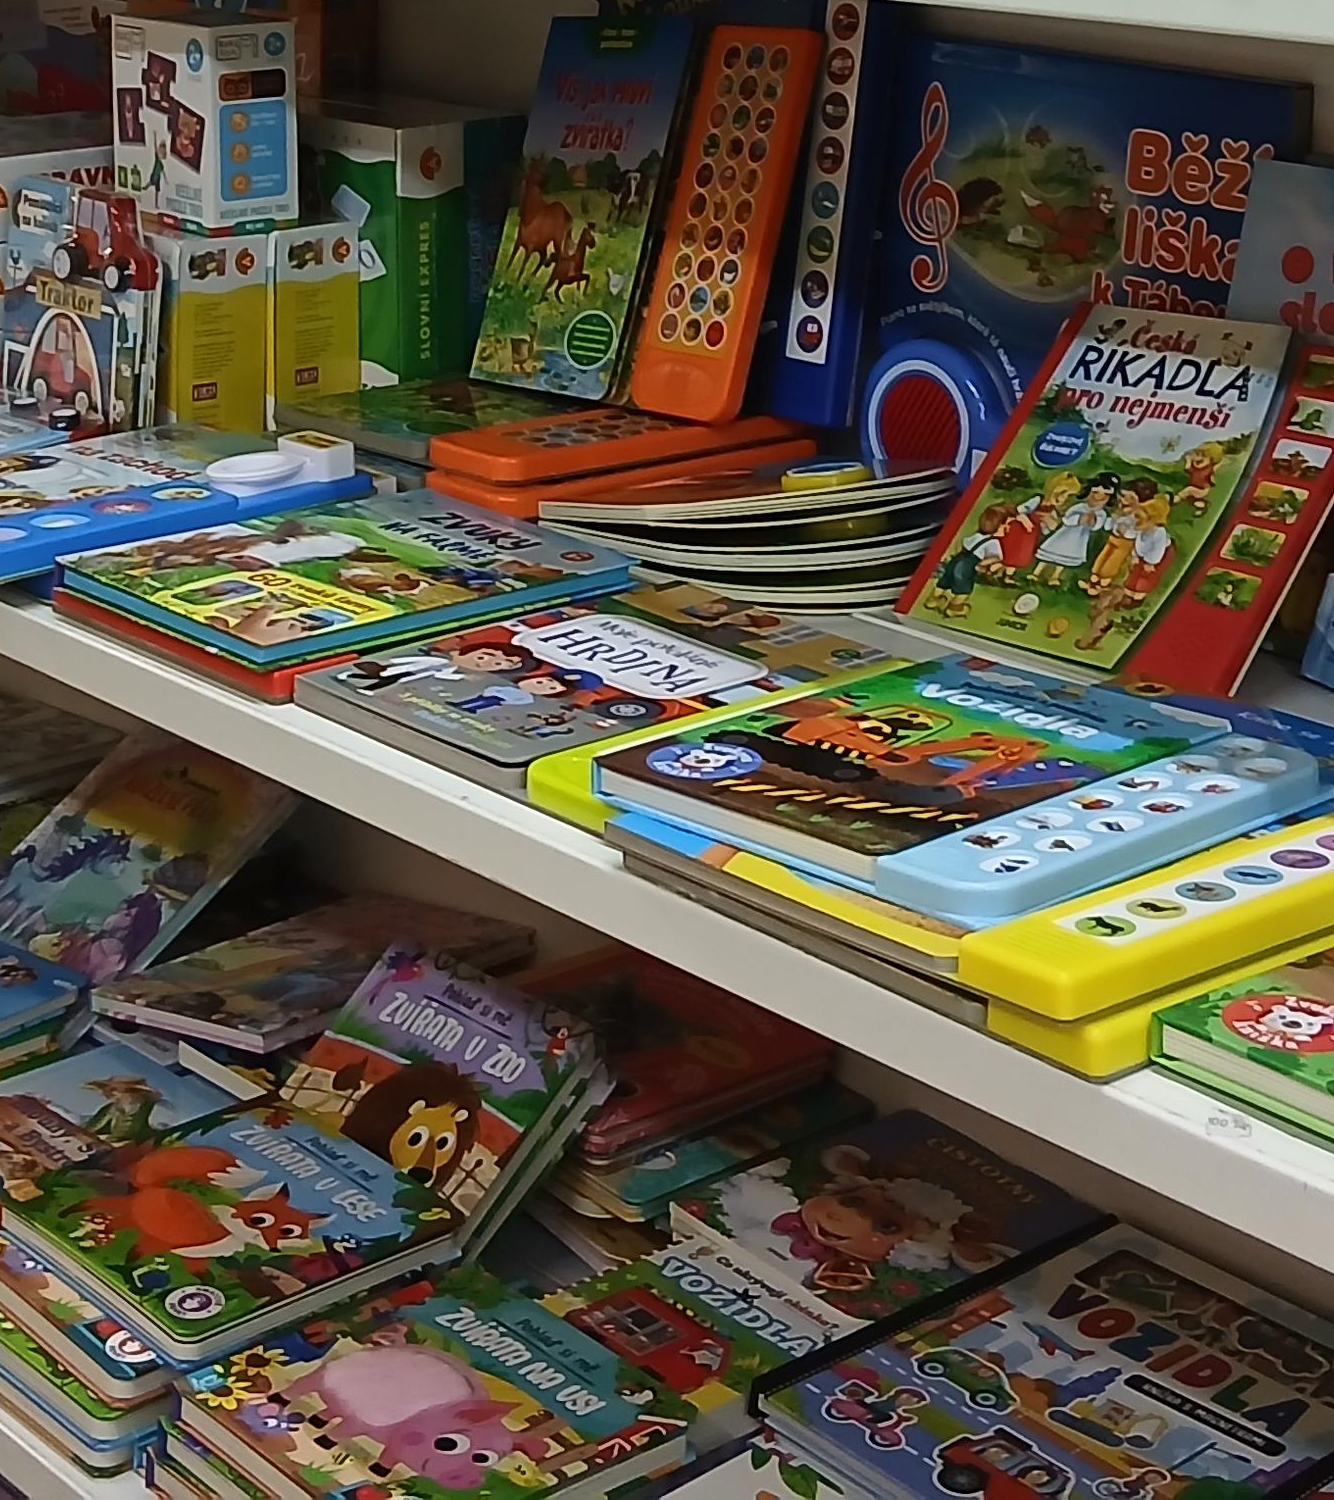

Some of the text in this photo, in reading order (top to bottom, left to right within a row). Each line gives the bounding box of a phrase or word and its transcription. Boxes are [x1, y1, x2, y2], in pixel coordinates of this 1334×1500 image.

[1126, 127, 1274, 213] Běž
[1109, 391, 1237, 431] nejmenší
[379, 520, 413, 541] NA
[419, 511, 542, 551] ZVUKY
[248, 571, 292, 588] 60
[539, 628, 710, 694] HRDINA
[919, 680, 1102, 746] Vozidla
[378, 992, 465, 1053] ZVÍŘATA
[481, 1043, 527, 1085] ZOO
[330, 1187, 388, 1222] LESE
[518, 1358, 566, 1391] NA
[555, 1384, 607, 1418] VSI
[1047, 1283, 1312, 1438] VOZIDLA
